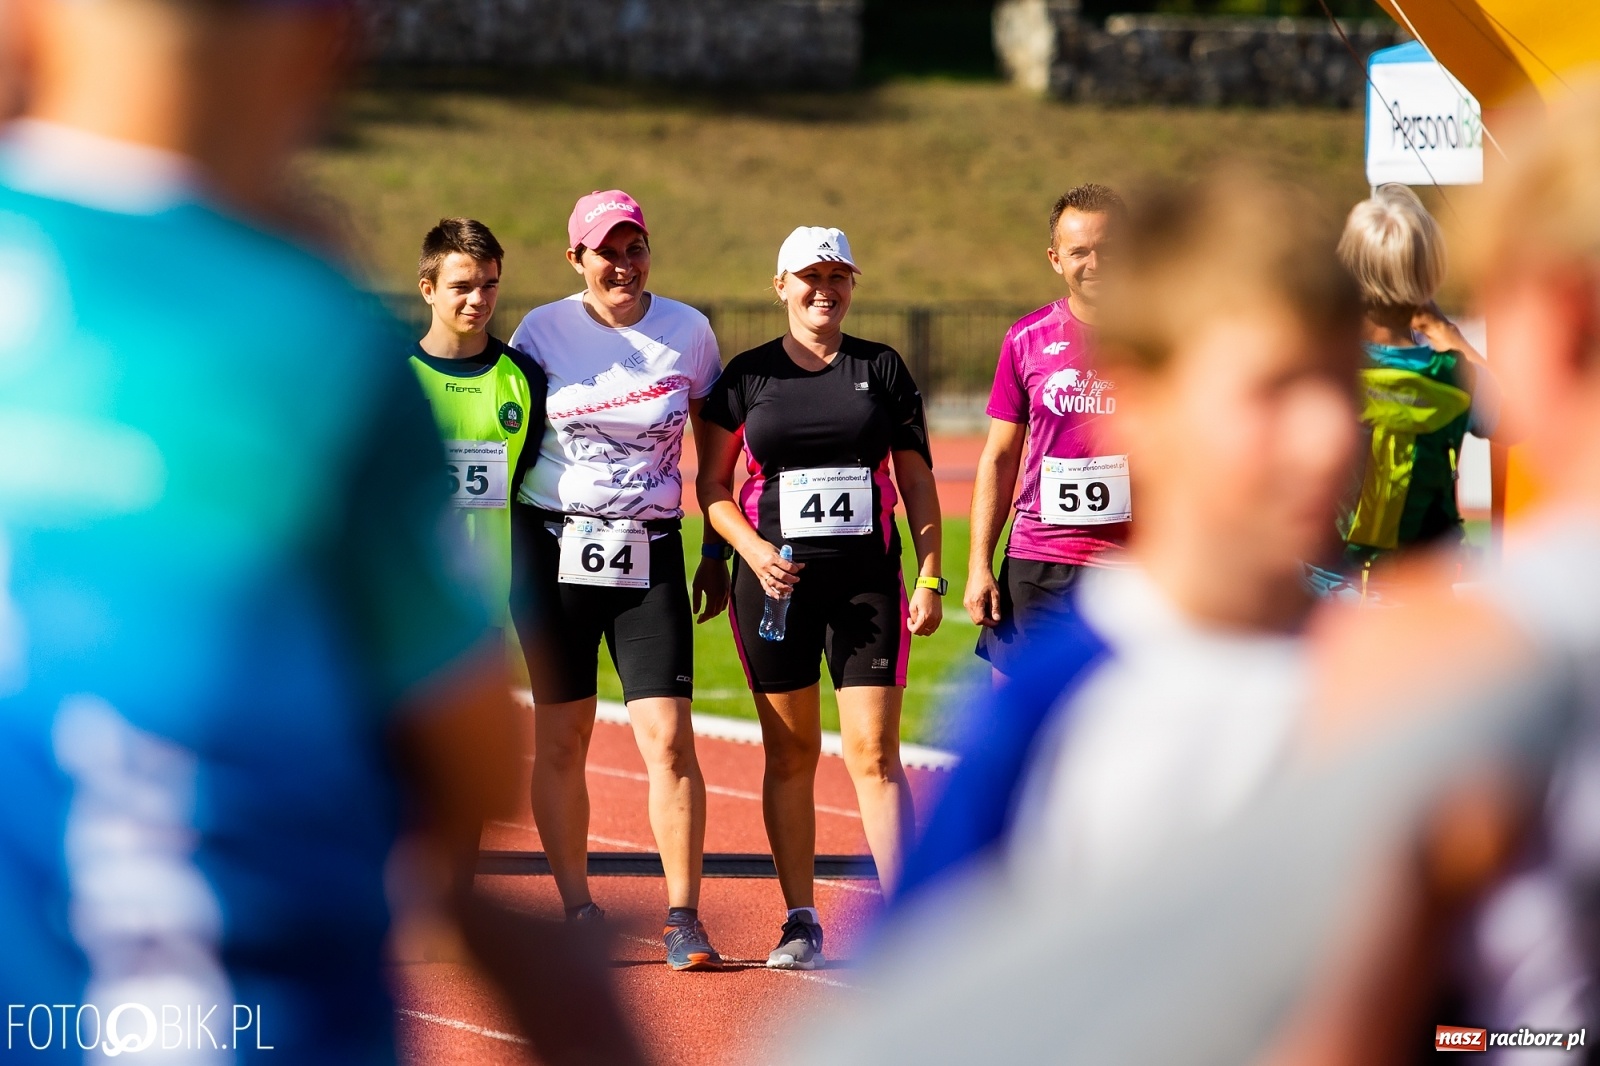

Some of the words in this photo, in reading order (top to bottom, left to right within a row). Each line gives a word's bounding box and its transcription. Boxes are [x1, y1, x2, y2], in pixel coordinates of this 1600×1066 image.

[585, 200, 634, 223] adidas
[1042, 341, 1070, 355] 4F
[582, 366, 618, 387] GRYF
[1059, 394, 1117, 415] WORLD
[1068, 462, 1125, 471] www.personalbest.pl
[800, 492, 854, 523] 44
[1058, 481, 1110, 512] 59
[581, 543, 634, 574] 64
